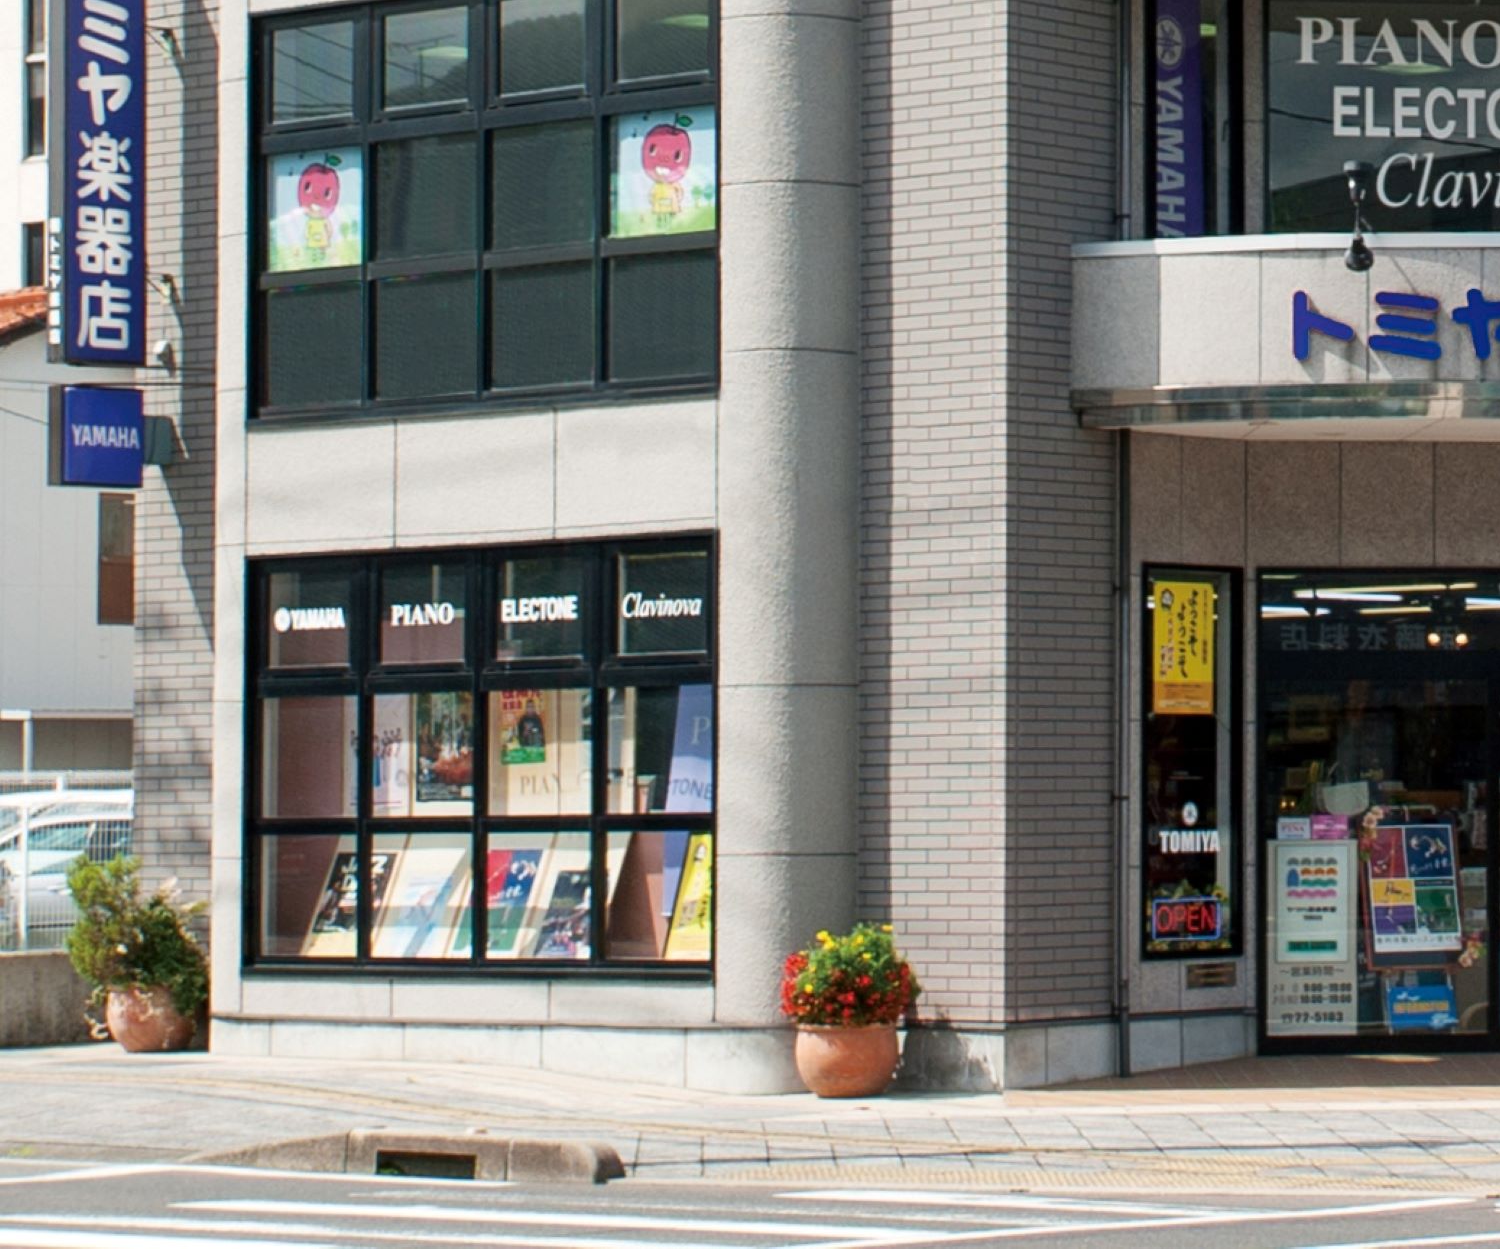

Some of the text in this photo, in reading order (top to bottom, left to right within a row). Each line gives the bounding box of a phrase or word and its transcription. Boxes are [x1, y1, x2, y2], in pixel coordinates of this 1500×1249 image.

[71, 421, 141, 450] YAMAHA
[290, 606, 346, 631] YAMAHA
[390, 602, 456, 627] PIANO
[501, 594, 579, 623] ELECTONE
[622, 590, 703, 619] Clavinova
[1158, 829, 1220, 854] TOMIYA
[1156, 905, 1217, 933] OPEN
